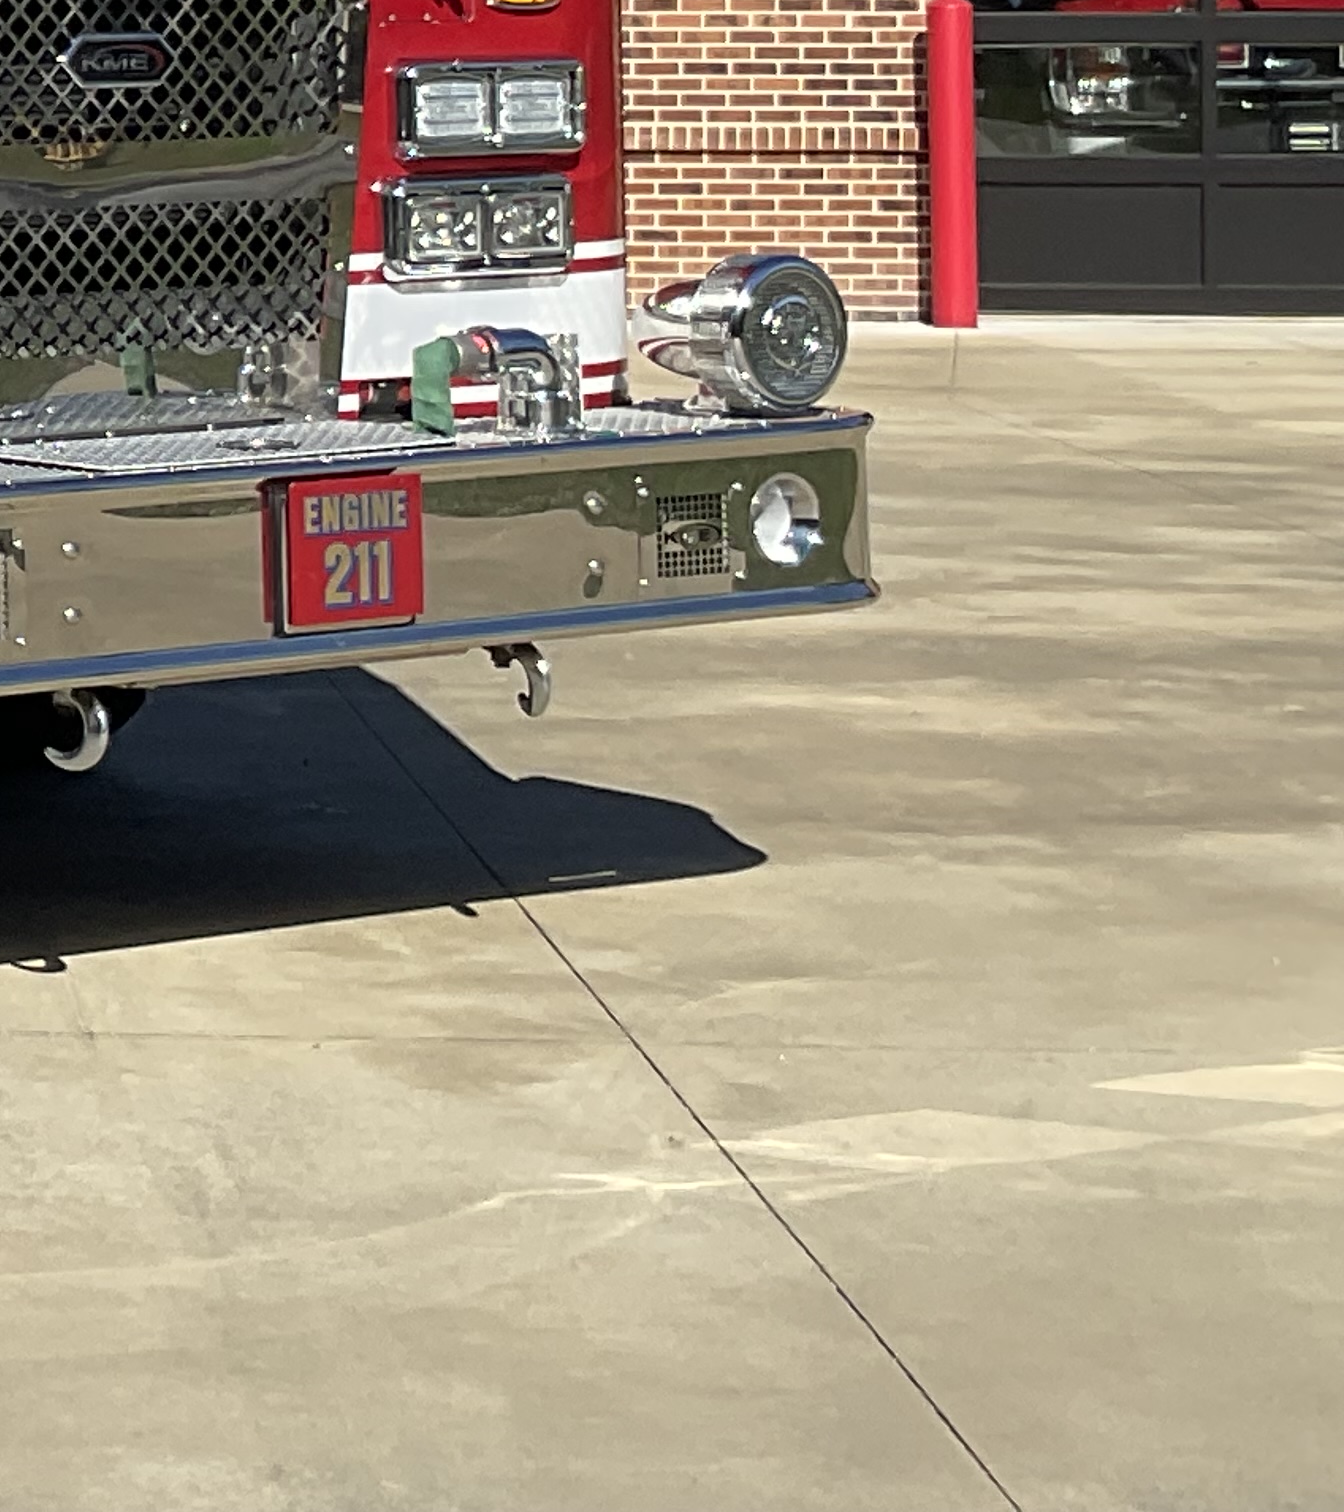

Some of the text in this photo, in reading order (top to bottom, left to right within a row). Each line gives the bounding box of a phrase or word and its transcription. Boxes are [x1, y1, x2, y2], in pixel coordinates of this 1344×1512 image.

[81, 53, 149, 73] KME
[302, 489, 409, 537] ENGINE
[663, 528, 714, 545] KE
[323, 538, 394, 610] 211
